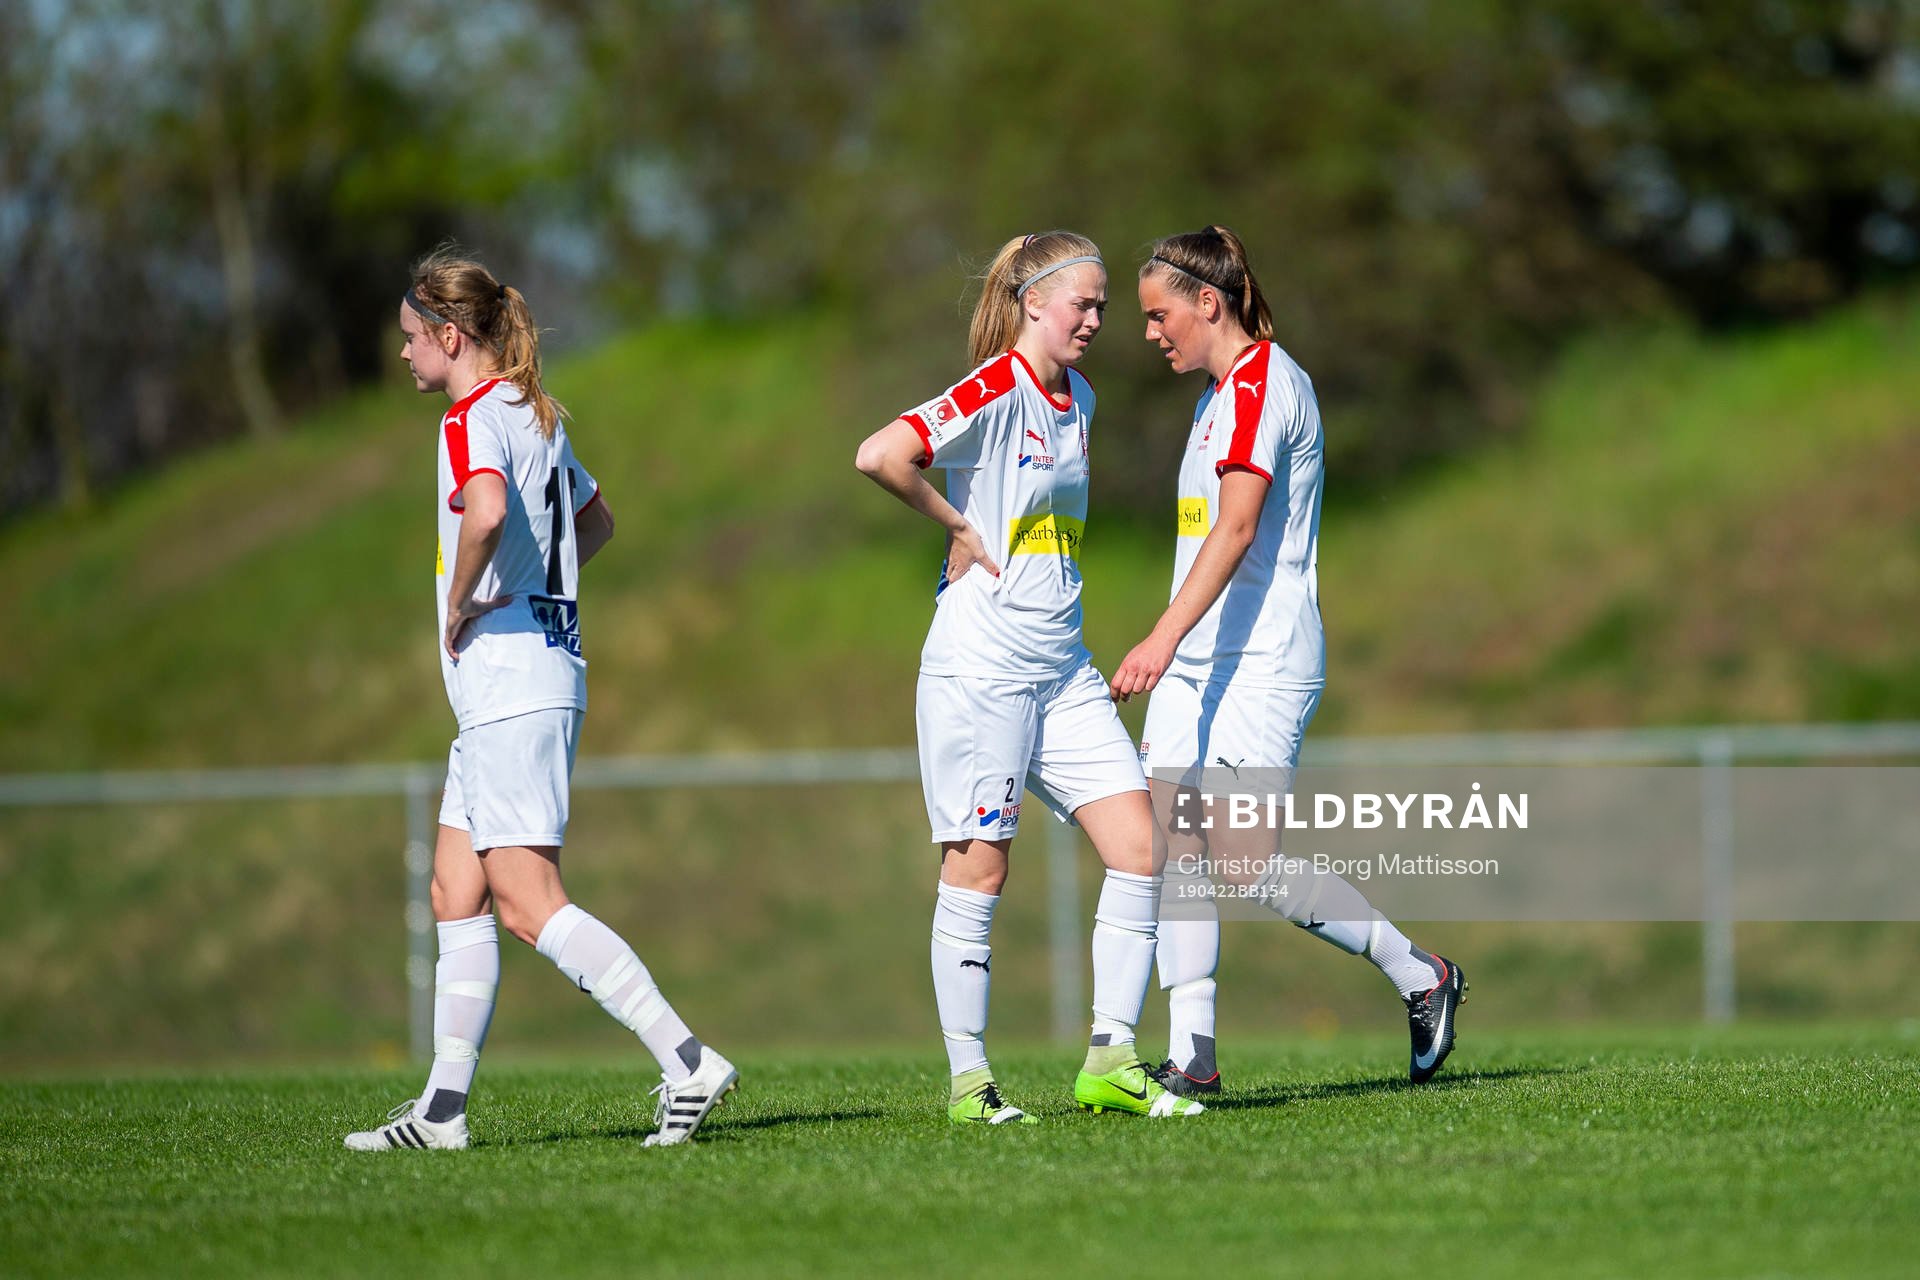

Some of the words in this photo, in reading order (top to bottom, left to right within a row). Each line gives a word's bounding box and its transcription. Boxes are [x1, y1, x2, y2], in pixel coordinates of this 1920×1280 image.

[1032, 455, 1054, 464] INTER
[1032, 462, 1054, 471] SPORT
[1184, 507, 1201, 528] Syd
[1004, 777, 1015, 803] 2
[1002, 804, 1022, 817] INTE
